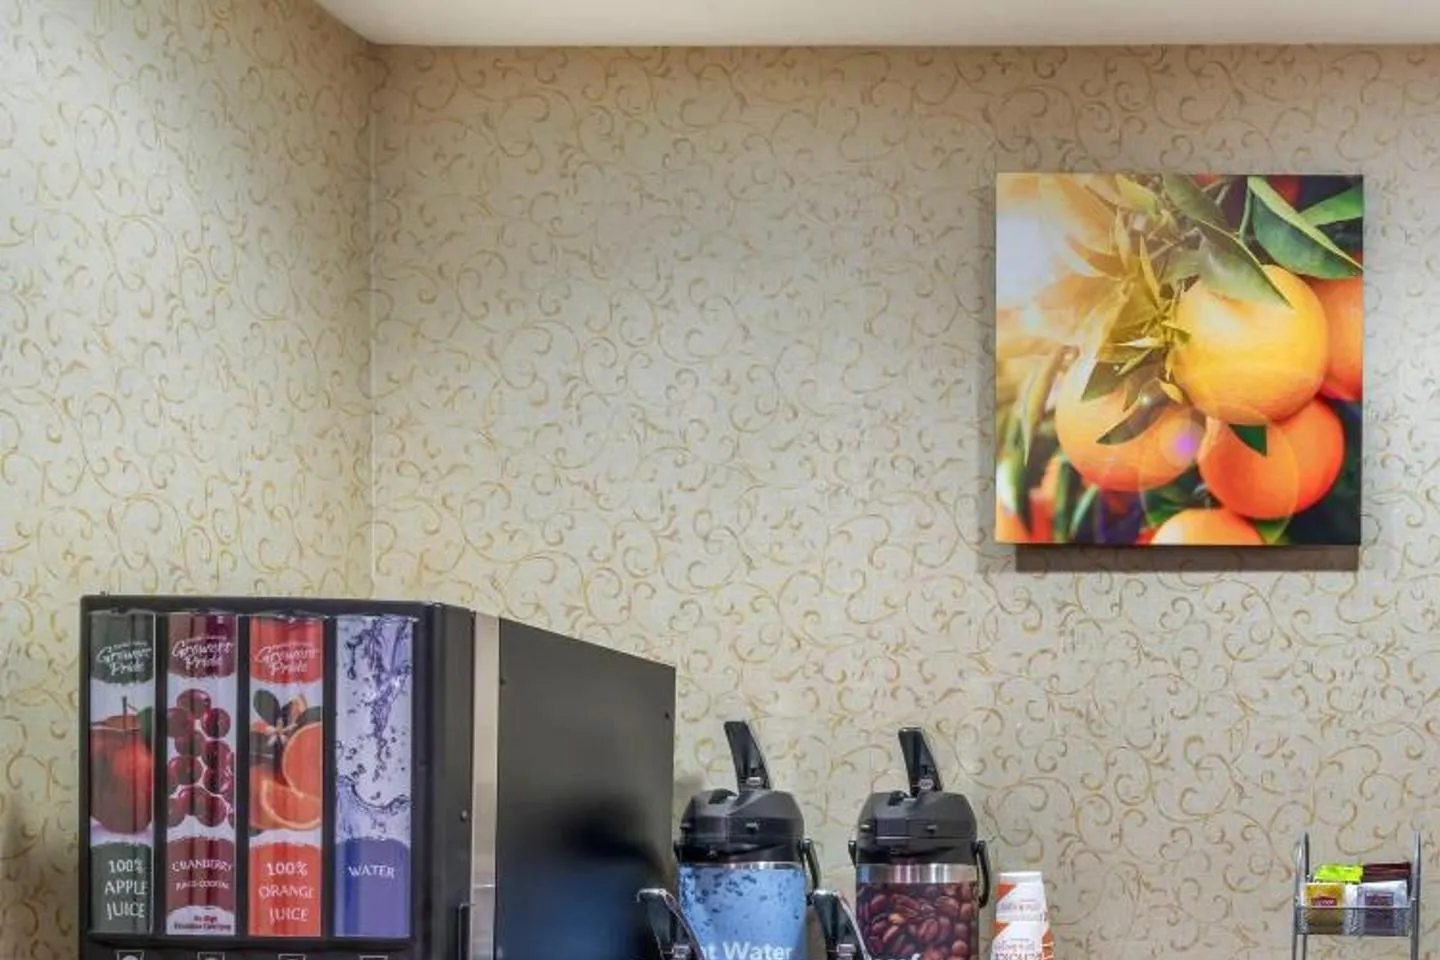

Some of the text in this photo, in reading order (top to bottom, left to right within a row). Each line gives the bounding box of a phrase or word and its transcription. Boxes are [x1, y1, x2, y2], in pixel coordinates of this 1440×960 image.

[108, 858, 145, 874] 100%
[266, 860, 309, 877] 100%
[348, 864, 396, 879] WATER
[104, 879, 147, 896] APPLE
[105, 901, 146, 921] JUICE
[268, 906, 310, 926] JUICE
[723, 941, 793, 960] Water
